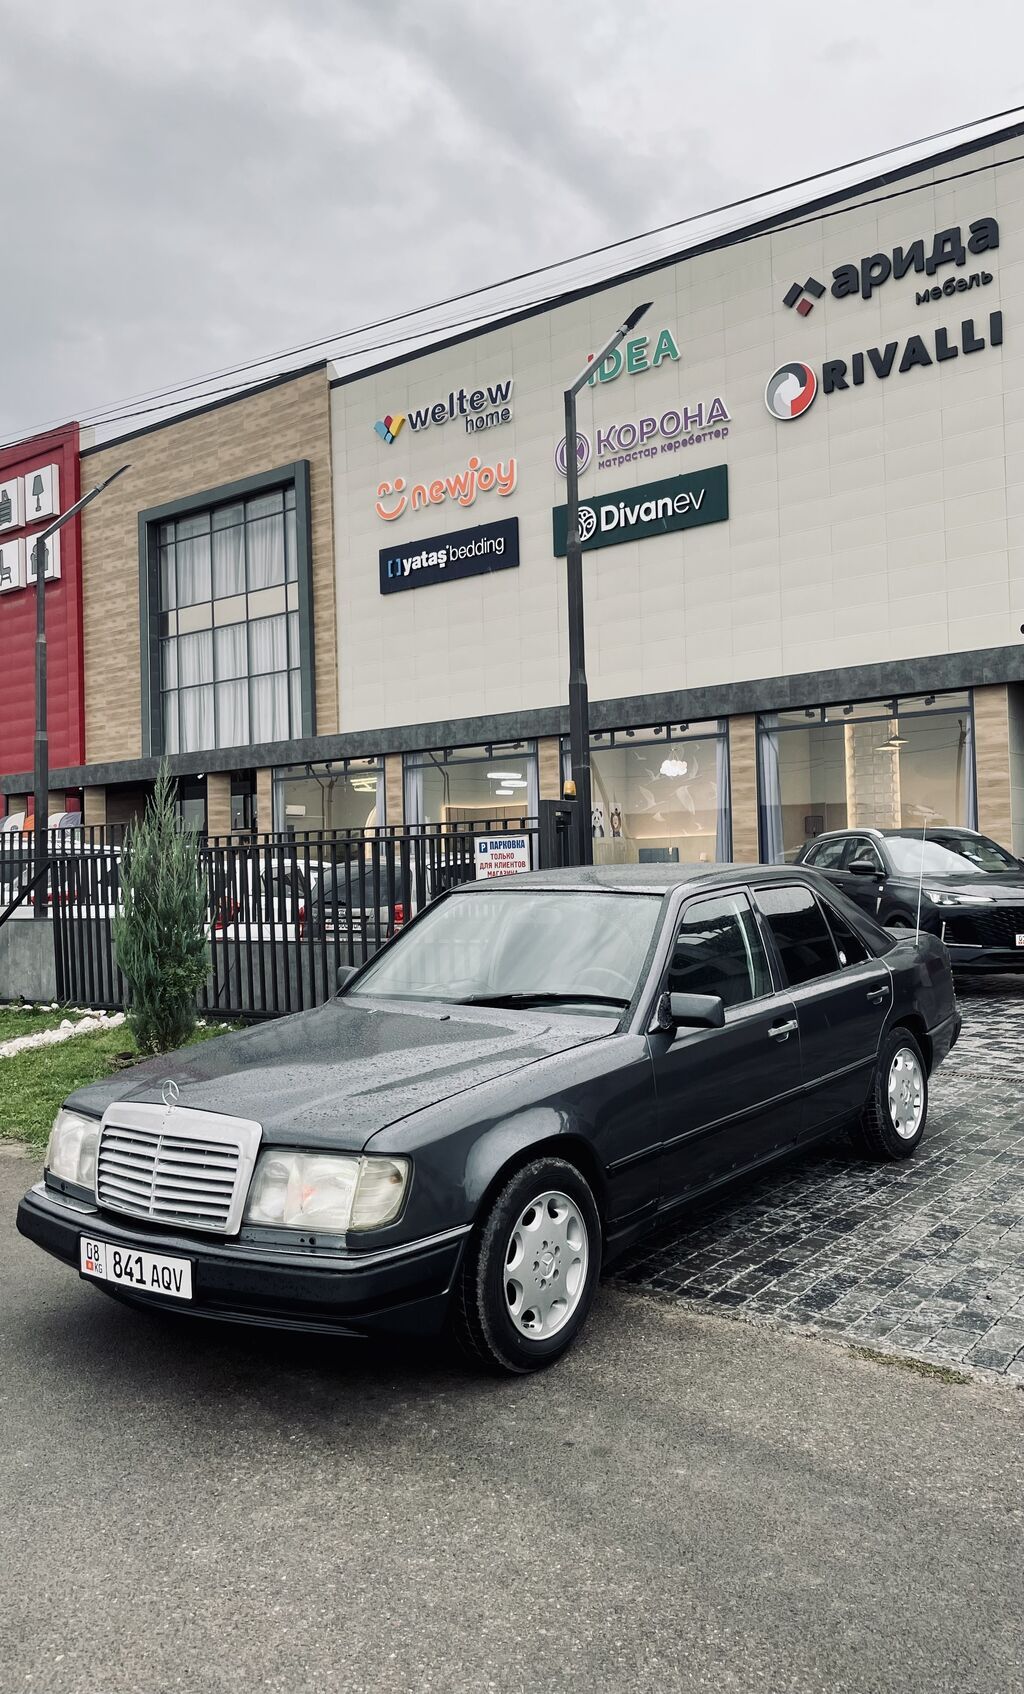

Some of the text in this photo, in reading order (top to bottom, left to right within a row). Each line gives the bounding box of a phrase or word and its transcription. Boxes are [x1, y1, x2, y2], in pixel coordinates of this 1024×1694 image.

[831, 217, 999, 299] арида
[916, 271, 993, 305] мебель
[822, 310, 1003, 394] RIVALLI
[407, 380, 512, 430] weltew
[465, 408, 511, 433] home
[597, 397, 729, 455] КОРОНА
[598, 446, 658, 470] матрастар
[411, 456, 516, 510] newjoy
[600, 488, 705, 532] Divanev
[449, 537, 505, 562] bedding
[490, 840, 526, 850] ПАРКОВКА
[490, 852, 515, 860] ТОЛЬКО
[480, 860, 526, 870] ДЛЯ КЛИЕНТОВ
[86, 1242, 100, 1261] 08
[94, 1262, 103, 1273] KG
[113, 1250, 183, 1292] 841 AQV
